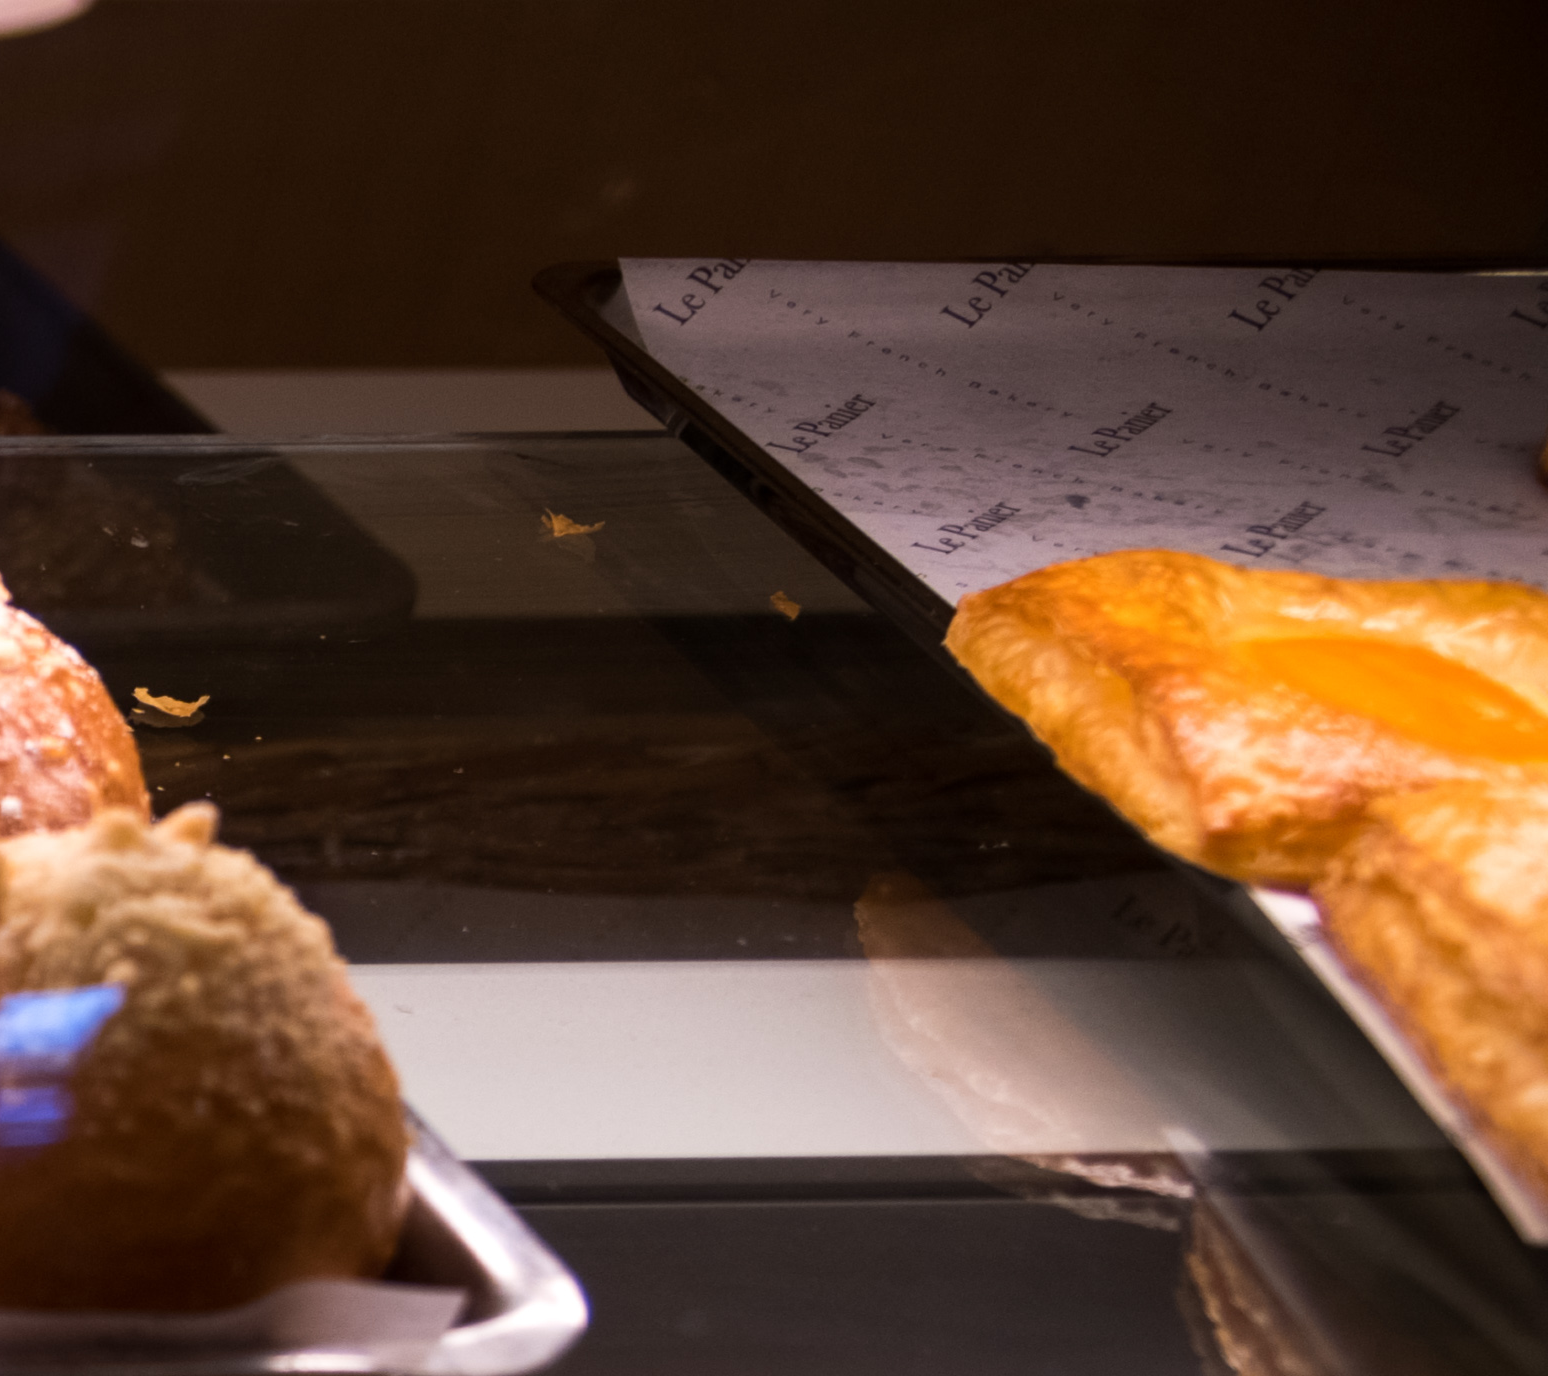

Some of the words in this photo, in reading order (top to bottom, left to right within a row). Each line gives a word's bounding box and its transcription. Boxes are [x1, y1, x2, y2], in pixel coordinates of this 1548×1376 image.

[653, 289, 706, 327] Le
[938, 293, 994, 330] Le
[1227, 298, 1282, 333] Le
[769, 288, 829, 327] Very
[847, 330, 948, 378] French
[1052, 290, 1114, 326] Very
[1133, 330, 1237, 379] French
[766, 428, 813, 456] Le
[794, 392, 878, 441] Panier
[1091, 401, 1175, 443] Panier
[1382, 399, 1463, 440] Panier
[1067, 436, 1120, 459] Le
[1361, 435, 1414, 459] Le
[911, 536, 965, 555] Le
[938, 500, 1022, 540] Panier
[1247, 499, 1328, 540] Panier
[1222, 535, 1274, 559] Le
